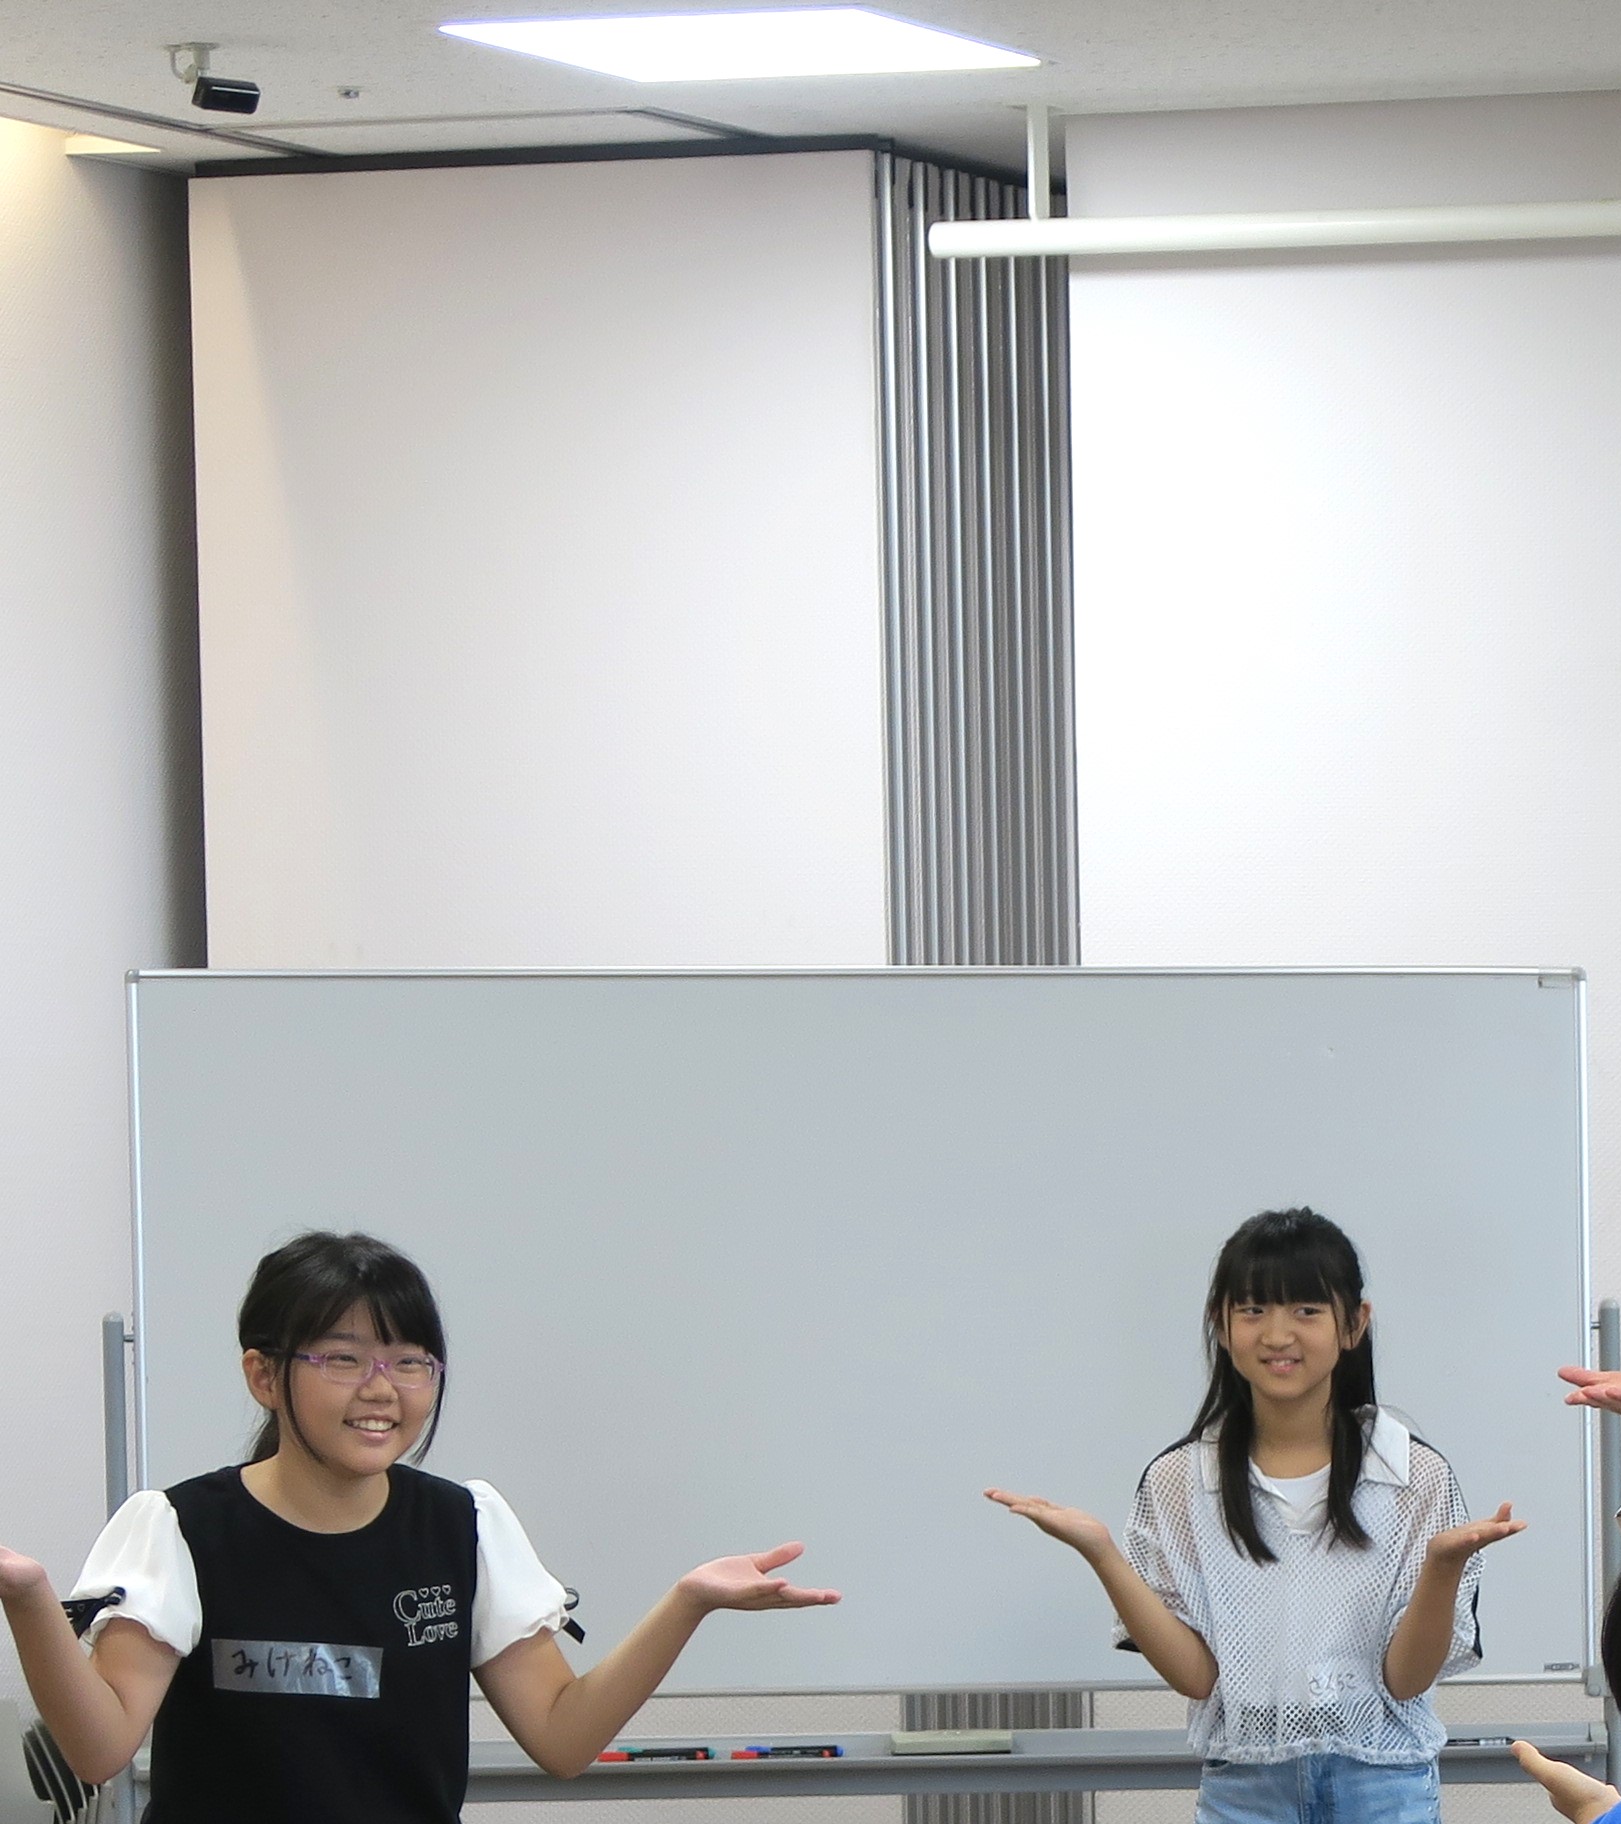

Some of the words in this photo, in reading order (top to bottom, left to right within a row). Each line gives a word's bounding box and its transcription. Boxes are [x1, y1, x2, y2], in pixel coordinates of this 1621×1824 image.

[393, 1589, 457, 1623] Cute
[404, 1621, 459, 1647] Love
[231, 1646, 353, 1681] みけねこ
